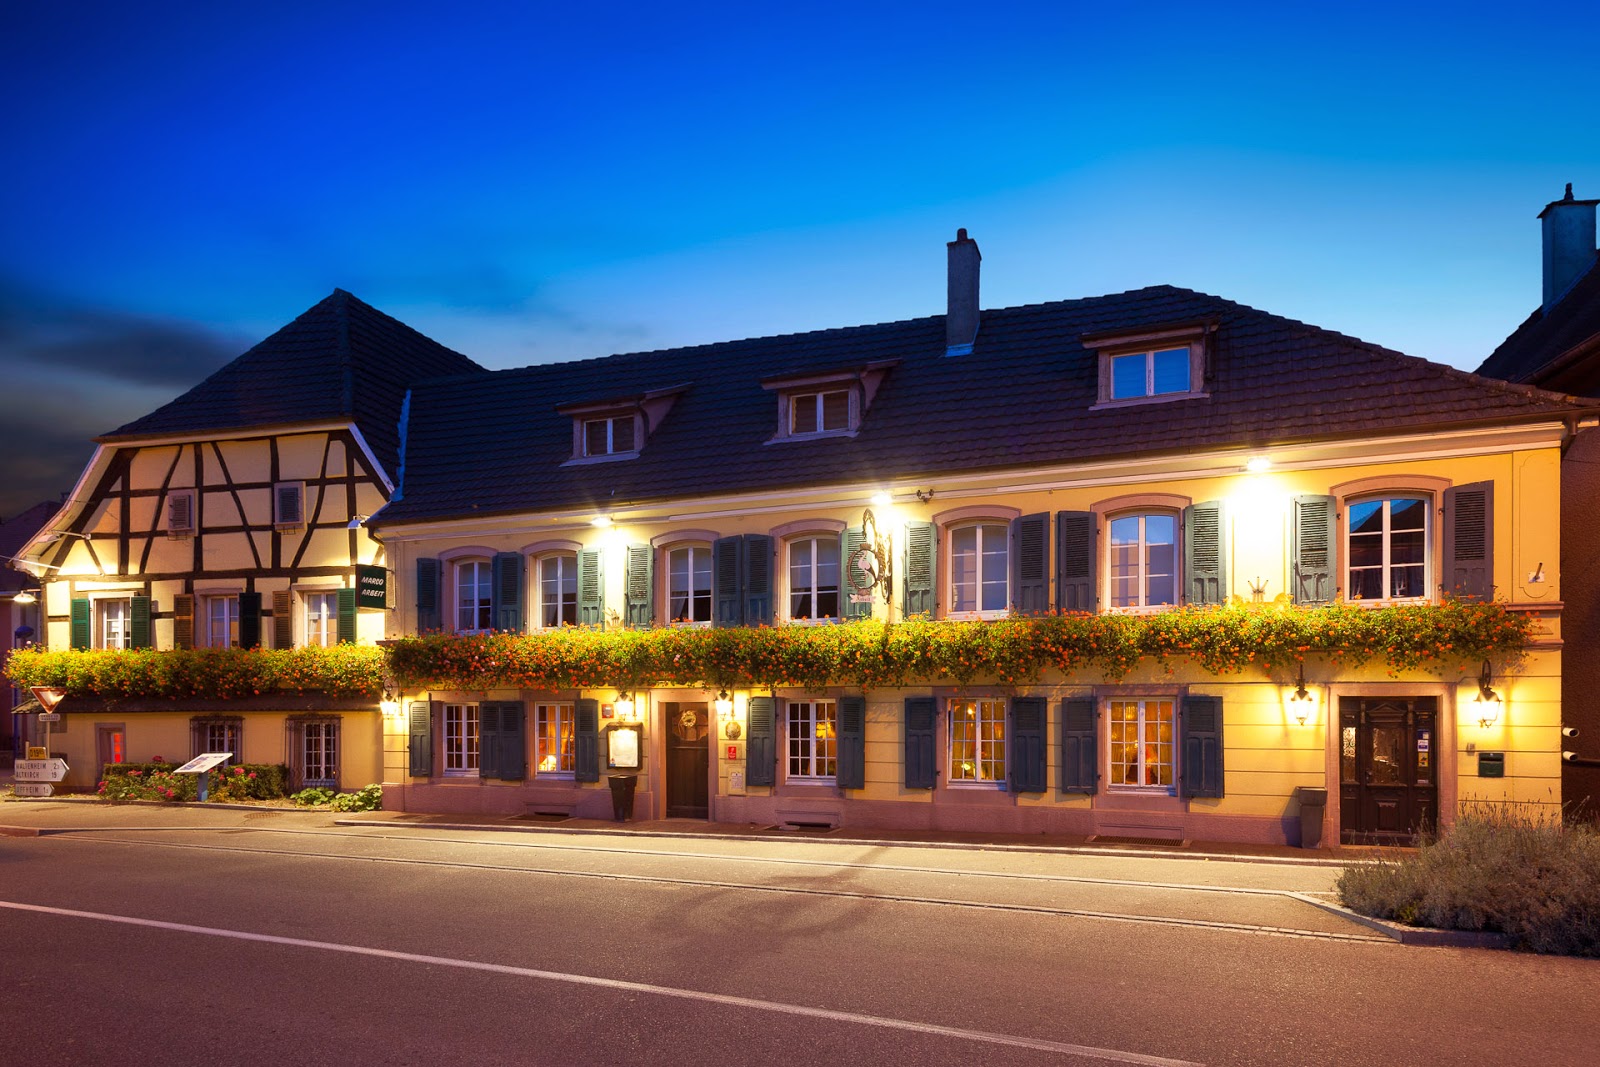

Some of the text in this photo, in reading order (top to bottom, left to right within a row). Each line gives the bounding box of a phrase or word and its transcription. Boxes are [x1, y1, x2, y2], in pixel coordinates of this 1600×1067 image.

[361, 576, 384, 586] MARCO
[361, 589, 385, 598] ARBEIT
[16, 771, 40, 779] ALTKIRCH
